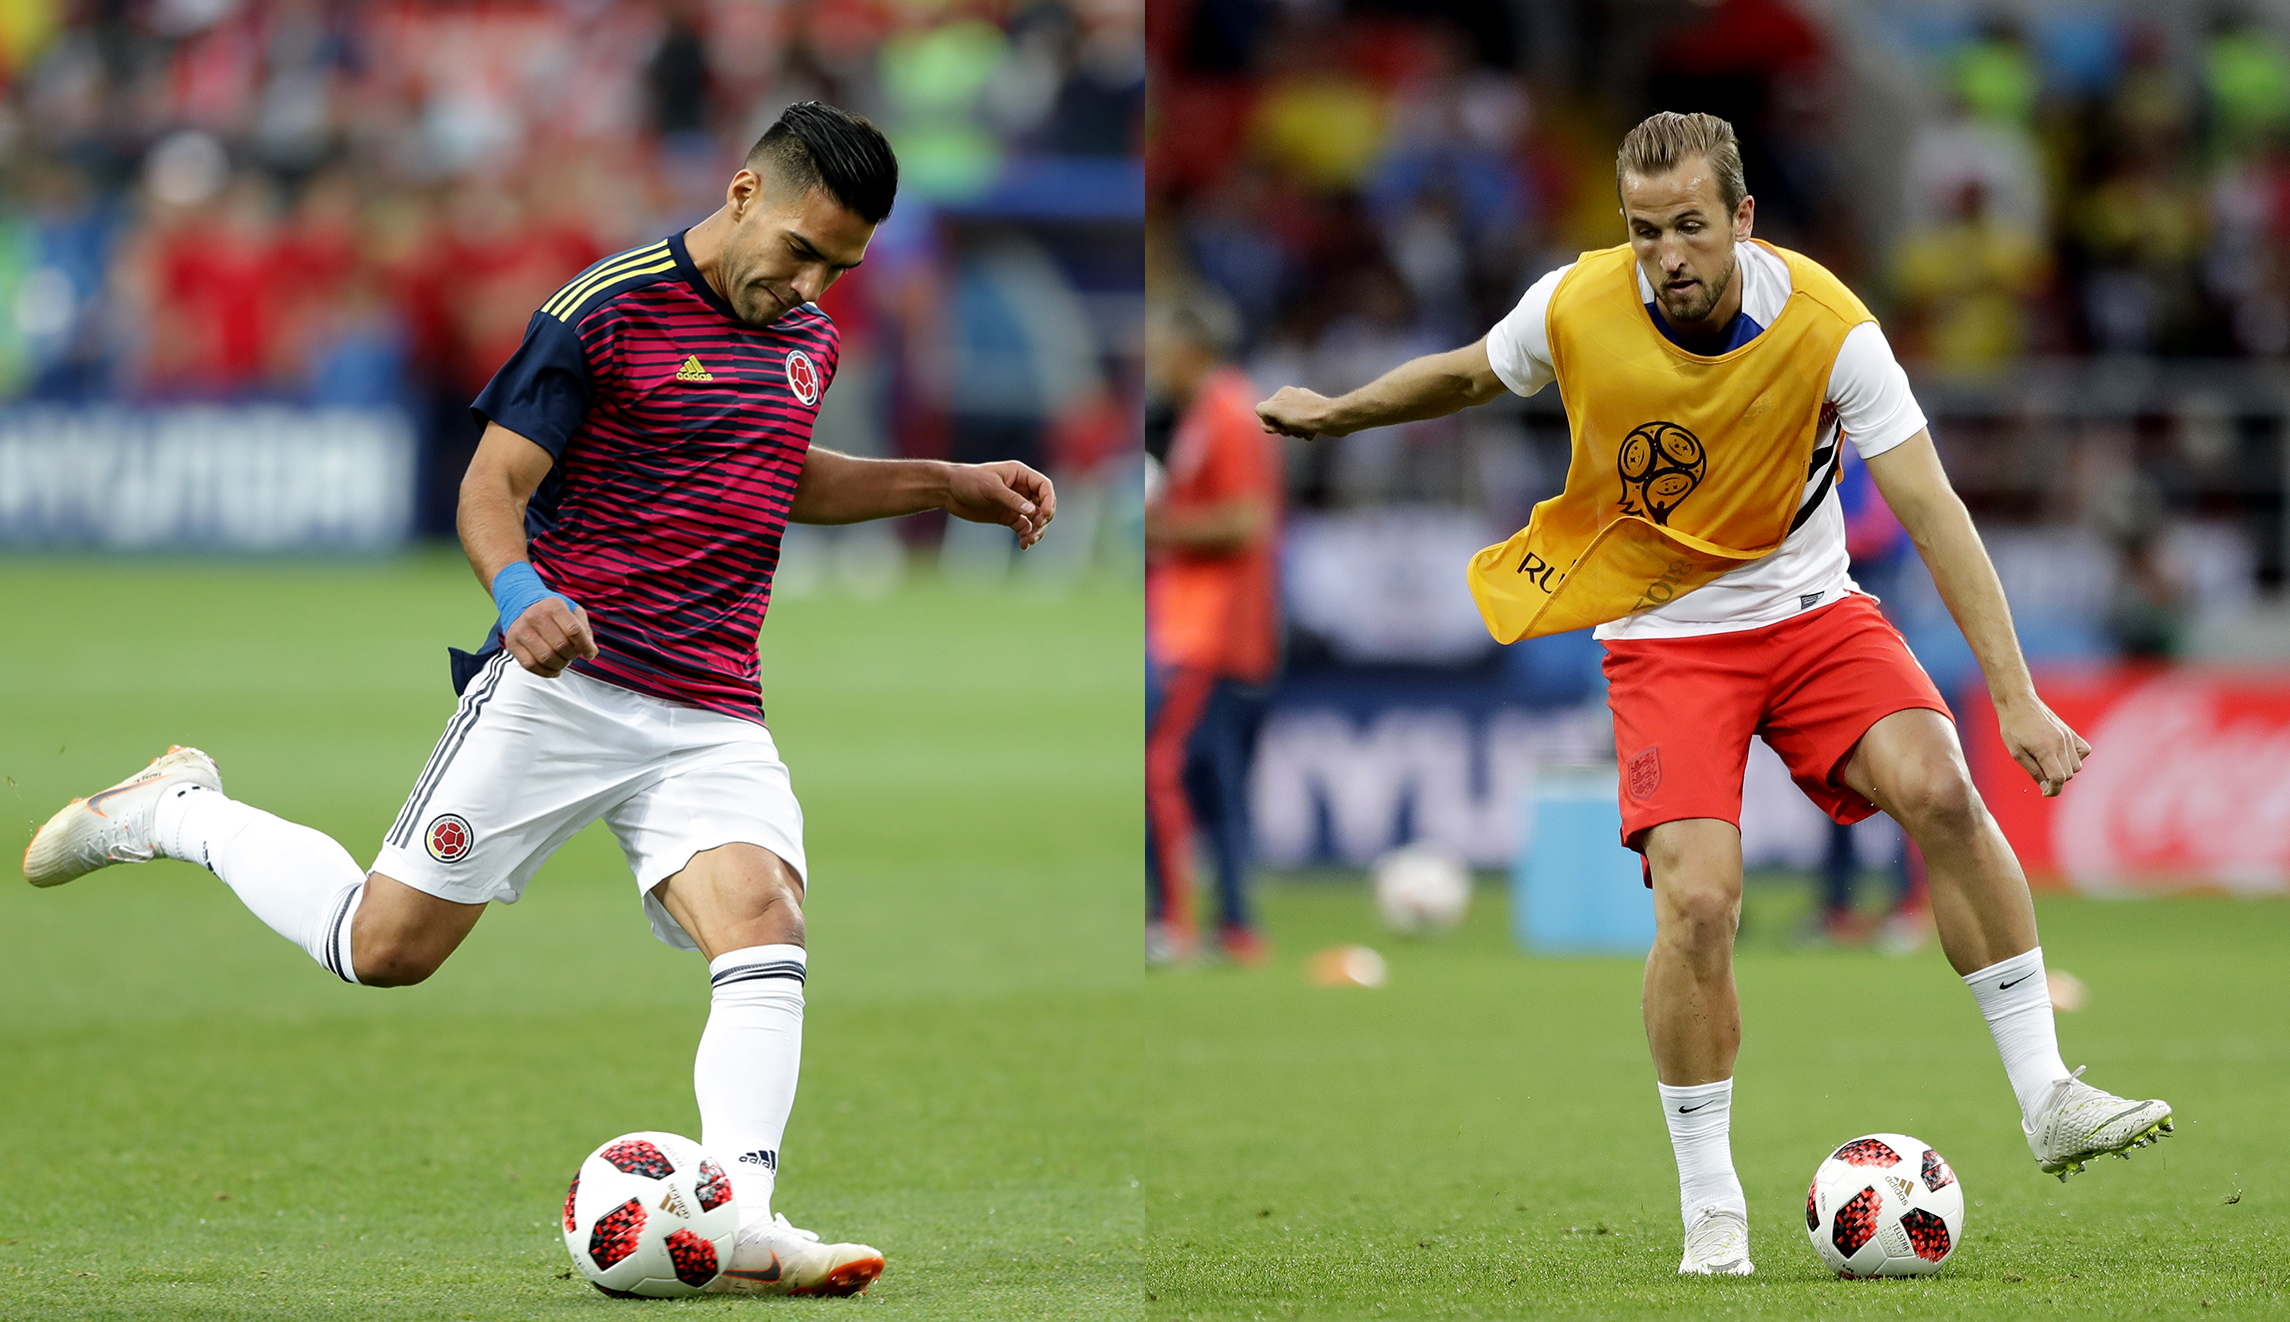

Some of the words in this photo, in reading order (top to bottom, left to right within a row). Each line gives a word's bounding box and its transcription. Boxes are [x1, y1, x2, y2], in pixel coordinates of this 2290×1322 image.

[676, 371, 714, 381] adidas
[1517, 551, 1577, 595] RU
[738, 1156, 775, 1175] adidas
[1885, 1175, 1909, 1206] adidas
[1892, 1222, 1910, 1252] TELSTAR
